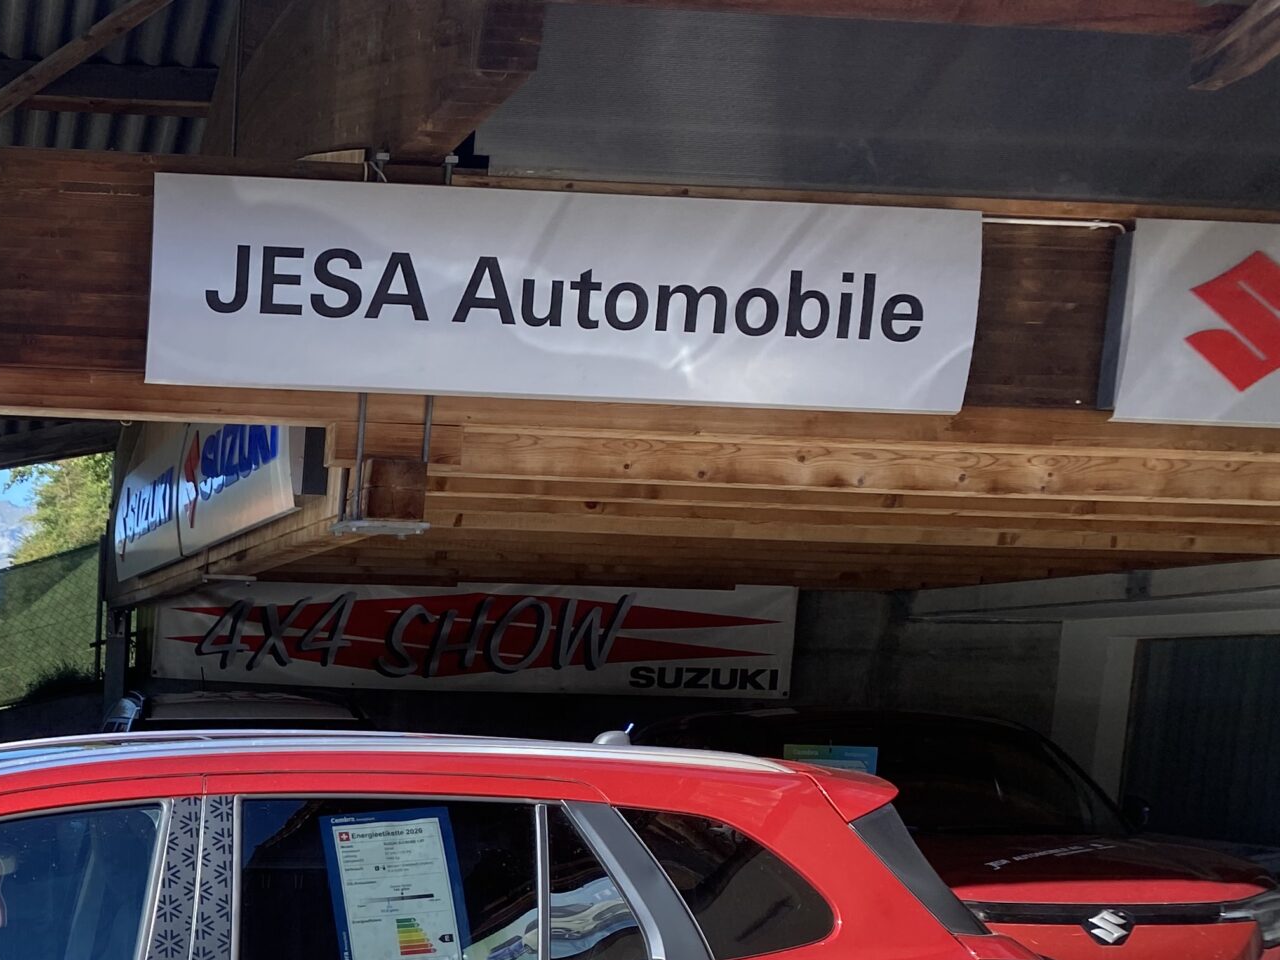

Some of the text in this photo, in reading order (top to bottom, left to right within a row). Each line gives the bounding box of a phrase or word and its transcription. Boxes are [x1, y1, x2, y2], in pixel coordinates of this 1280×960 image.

[204, 243, 925, 343] JESA Automobile
[377, 591, 637, 679] SHOW
[629, 666, 779, 692] SUZUKI
